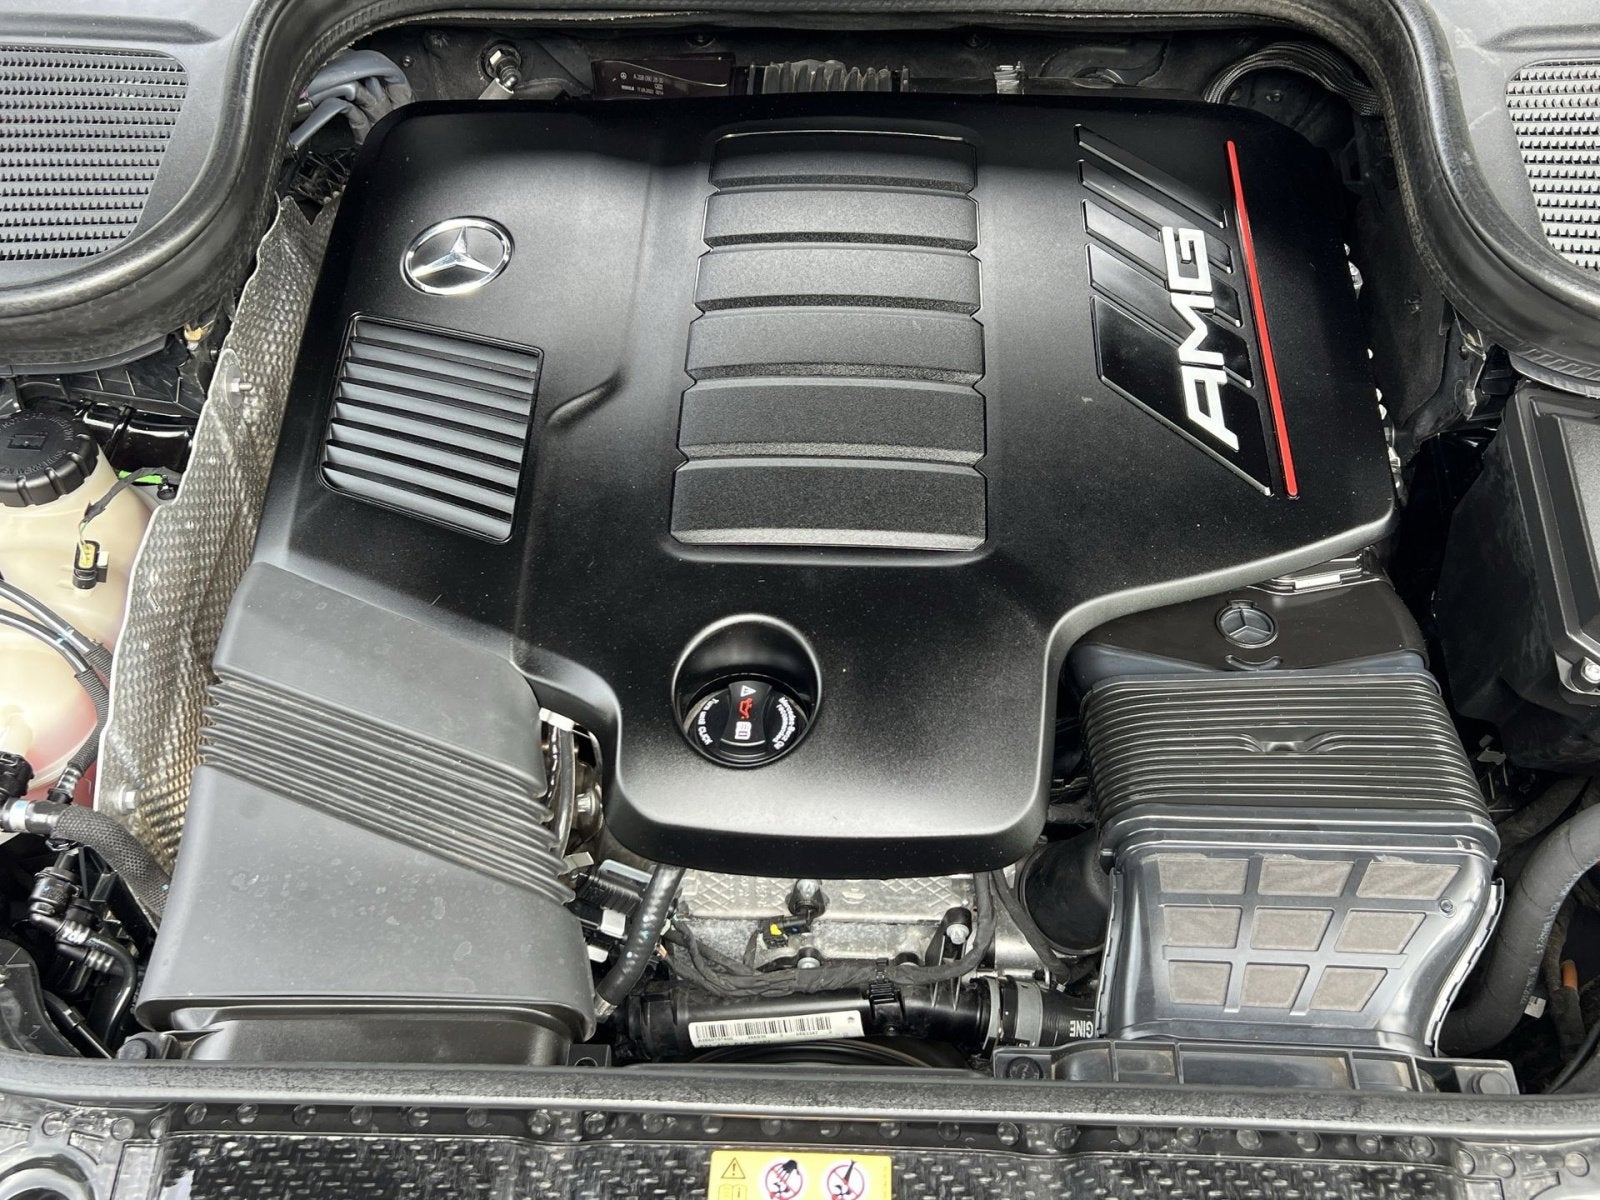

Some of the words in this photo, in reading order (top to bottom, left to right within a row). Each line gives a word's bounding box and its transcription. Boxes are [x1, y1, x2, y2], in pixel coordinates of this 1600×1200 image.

[1161, 226, 1240, 451] AMG
[698, 726, 713, 745] CLICK
[1069, 1020, 1094, 1038] GINE
